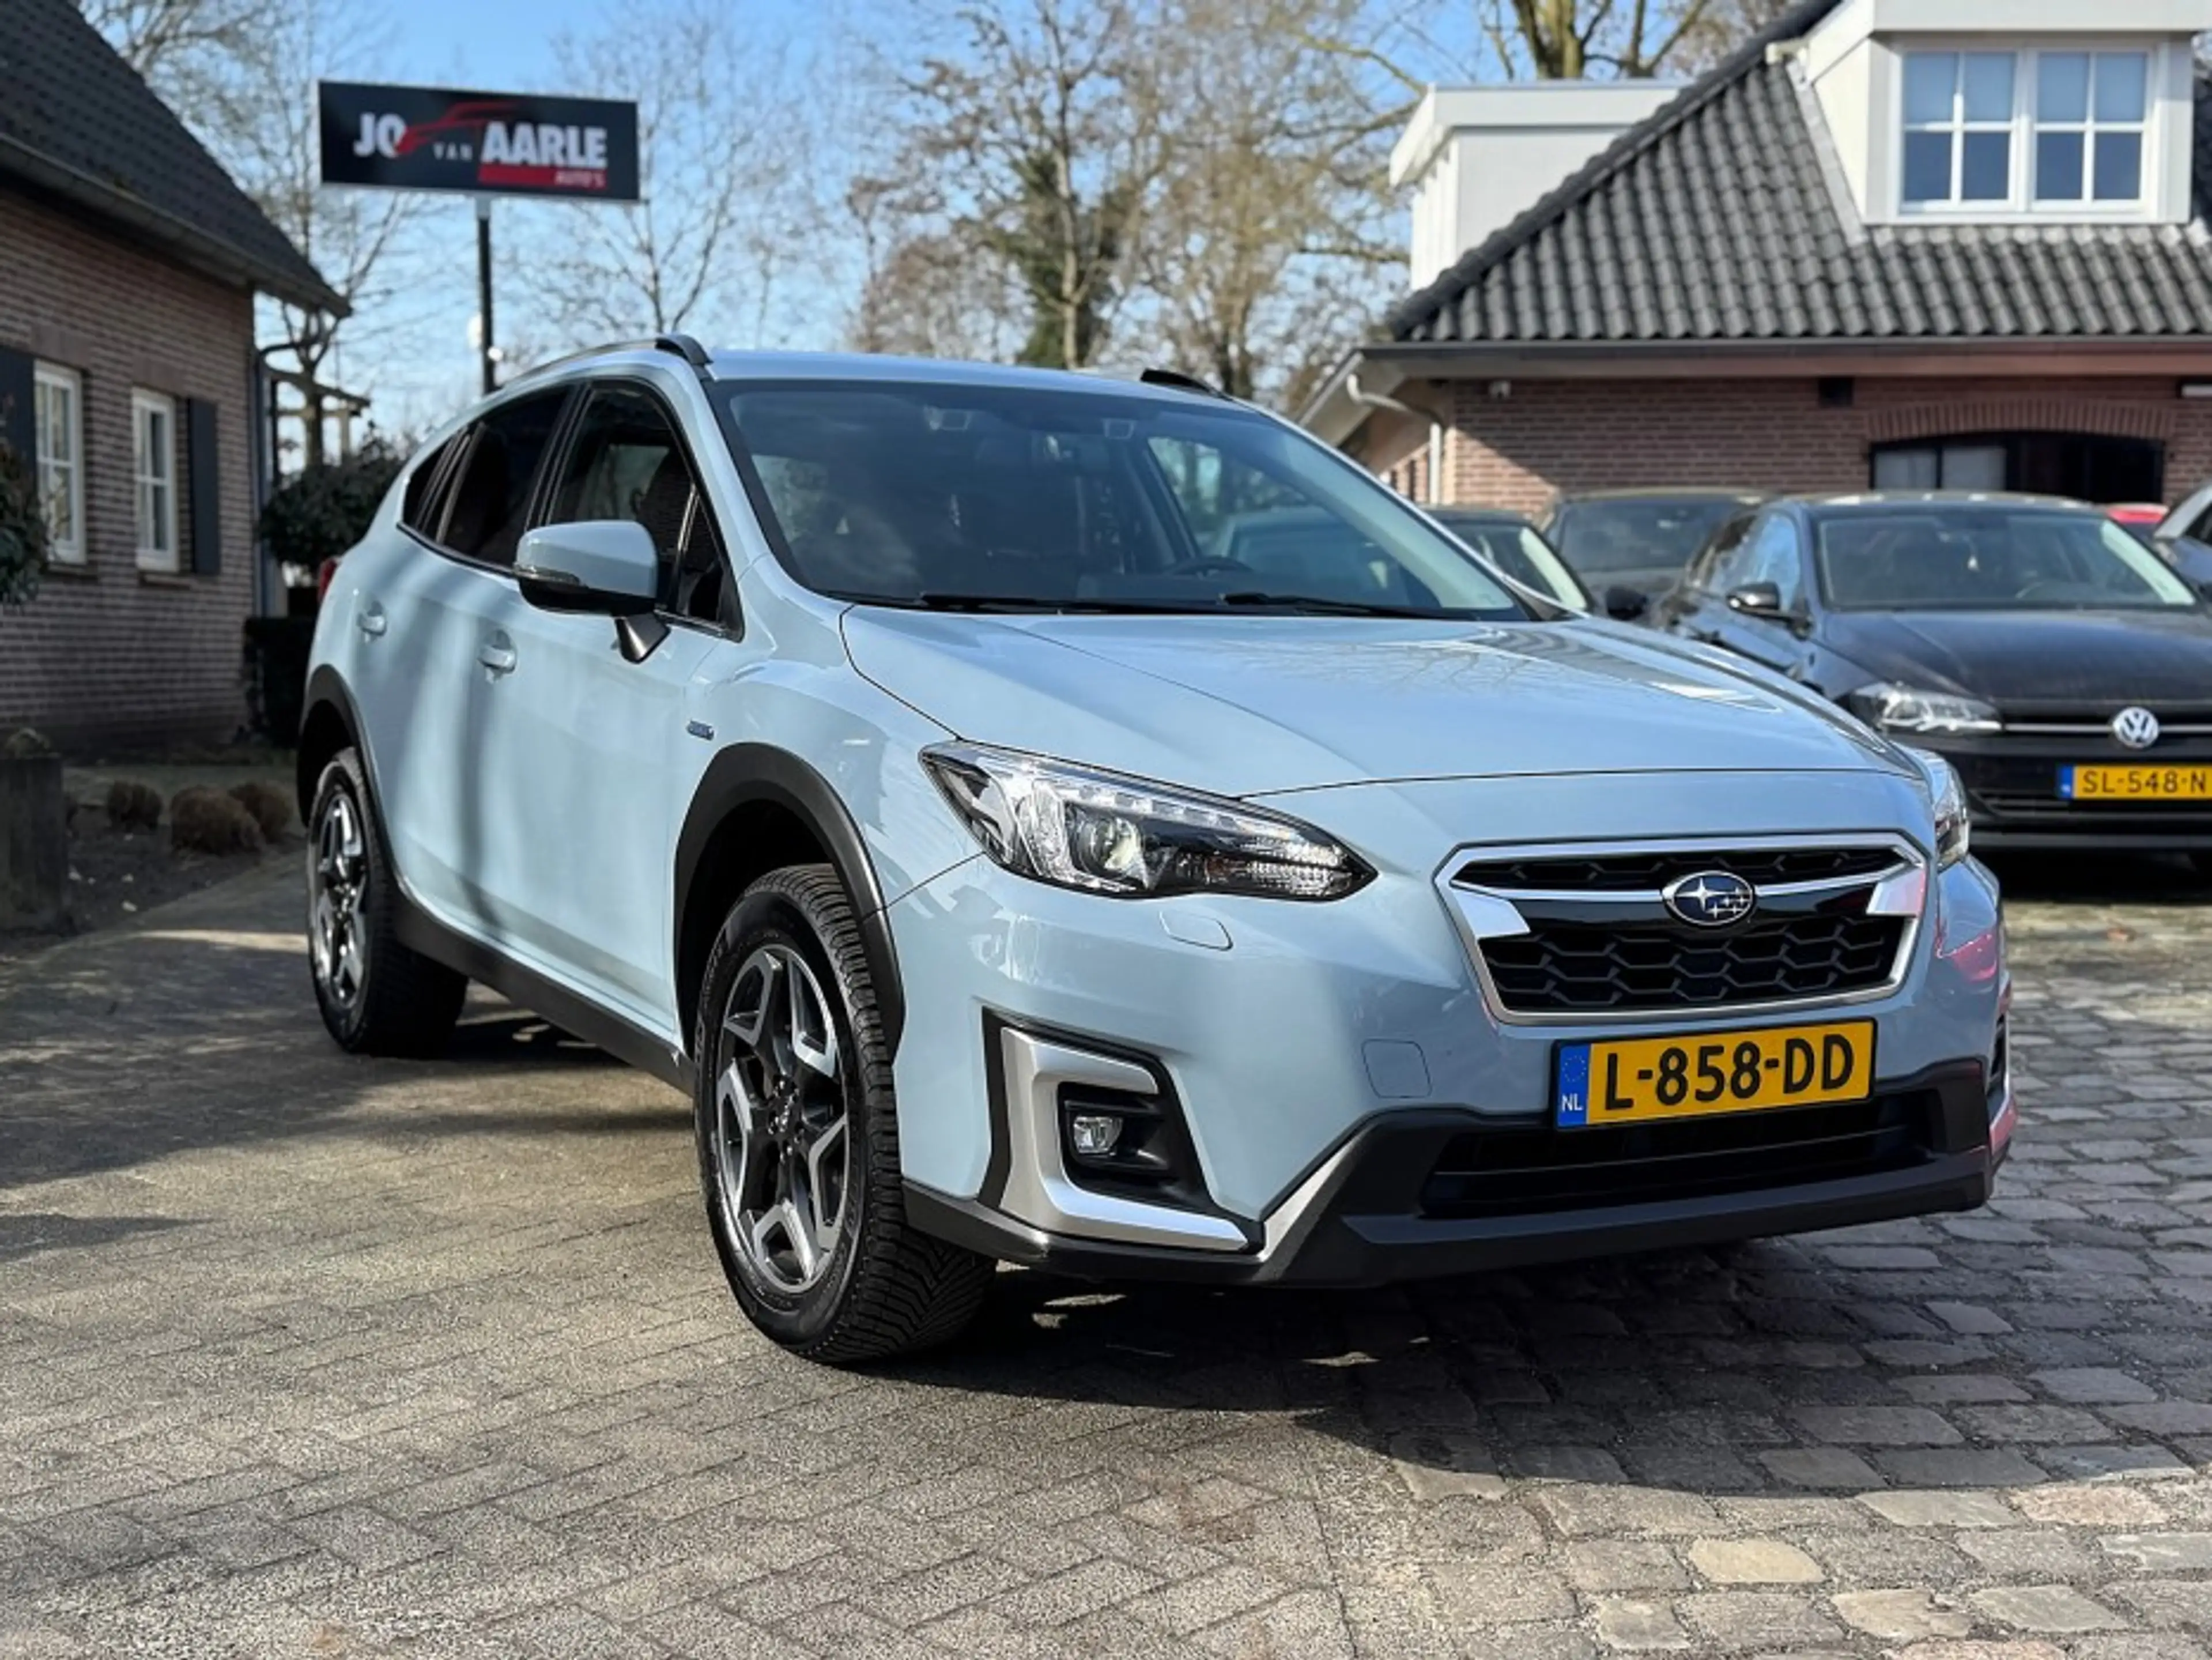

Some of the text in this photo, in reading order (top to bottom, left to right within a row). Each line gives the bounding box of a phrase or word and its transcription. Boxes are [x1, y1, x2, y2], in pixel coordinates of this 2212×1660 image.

[353, 112, 608, 168] JO VAN AARLE
[2082, 769, 2207, 794] SL-548-N
[1605, 1033, 1854, 1111] L-858-DD
[1561, 1092, 1584, 1112] NL
